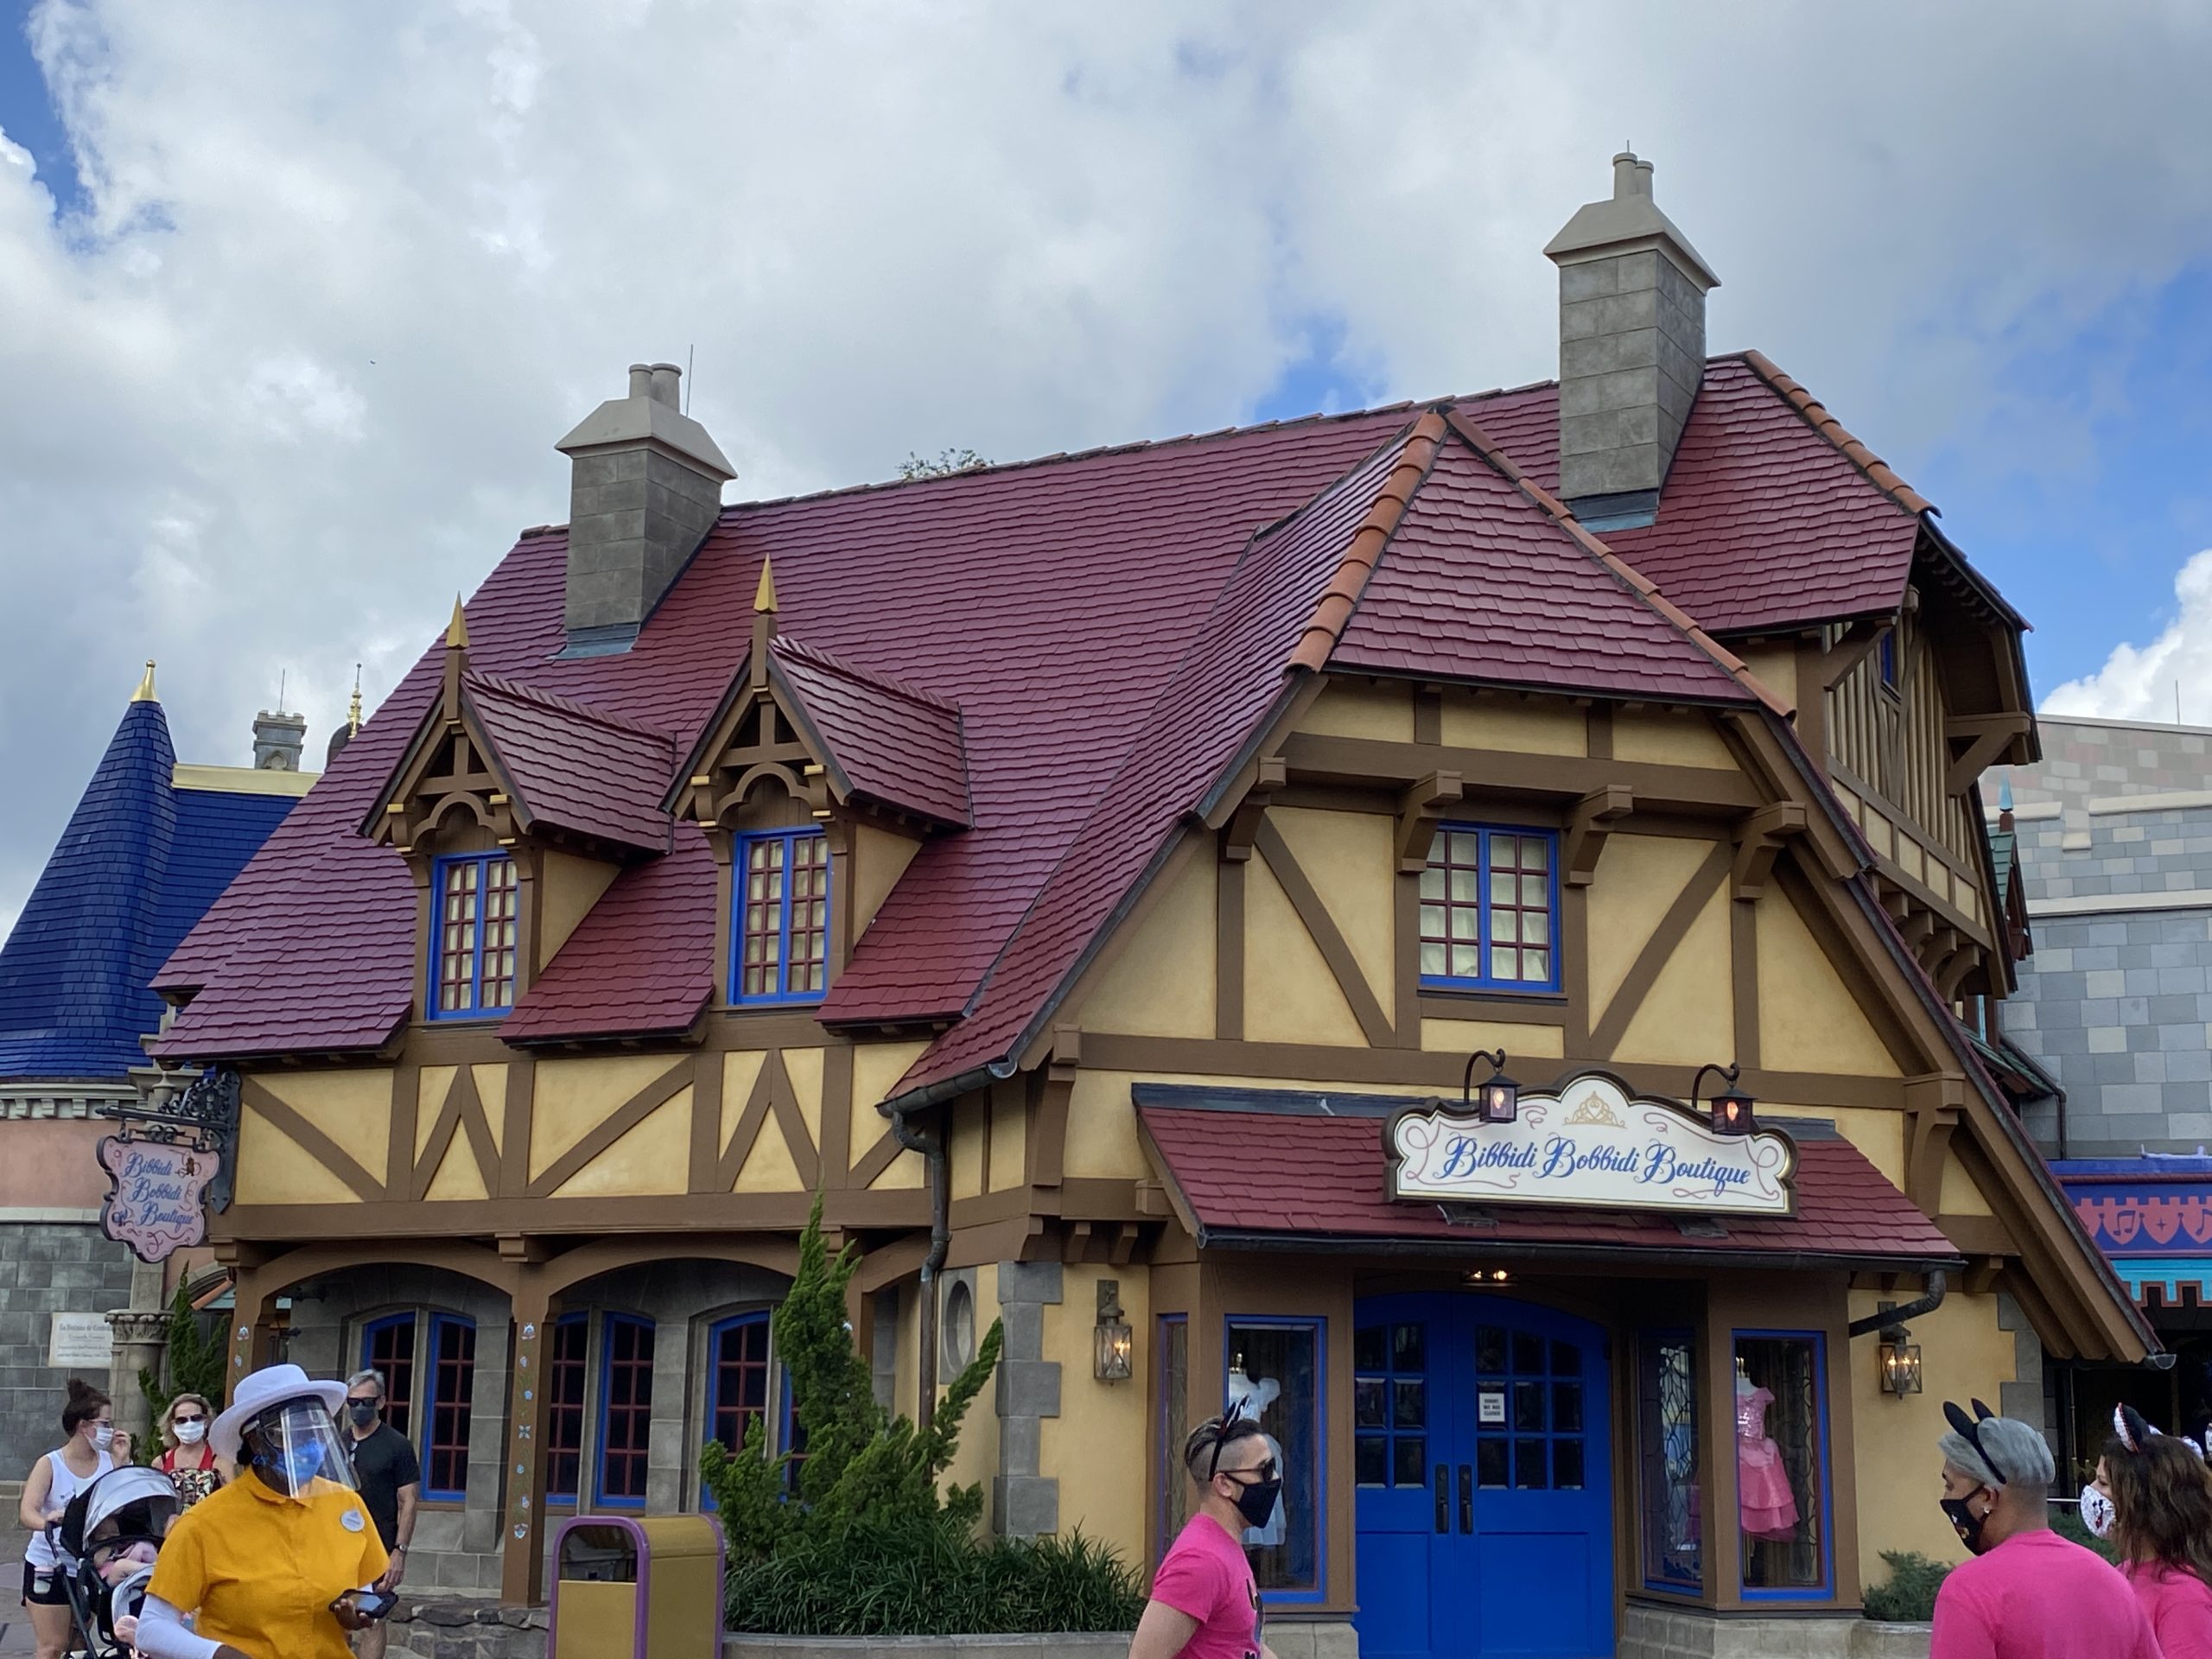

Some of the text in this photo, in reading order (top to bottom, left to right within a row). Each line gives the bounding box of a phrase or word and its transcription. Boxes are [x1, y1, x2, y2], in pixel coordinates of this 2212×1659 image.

[121, 1152, 172, 1178] Bibbidi
[1433, 1132, 1751, 1198] Bibbidi Bobbidi Boutique
[129, 1176, 182, 1203] Bobbidi
[137, 1201, 194, 1233] Boutique
